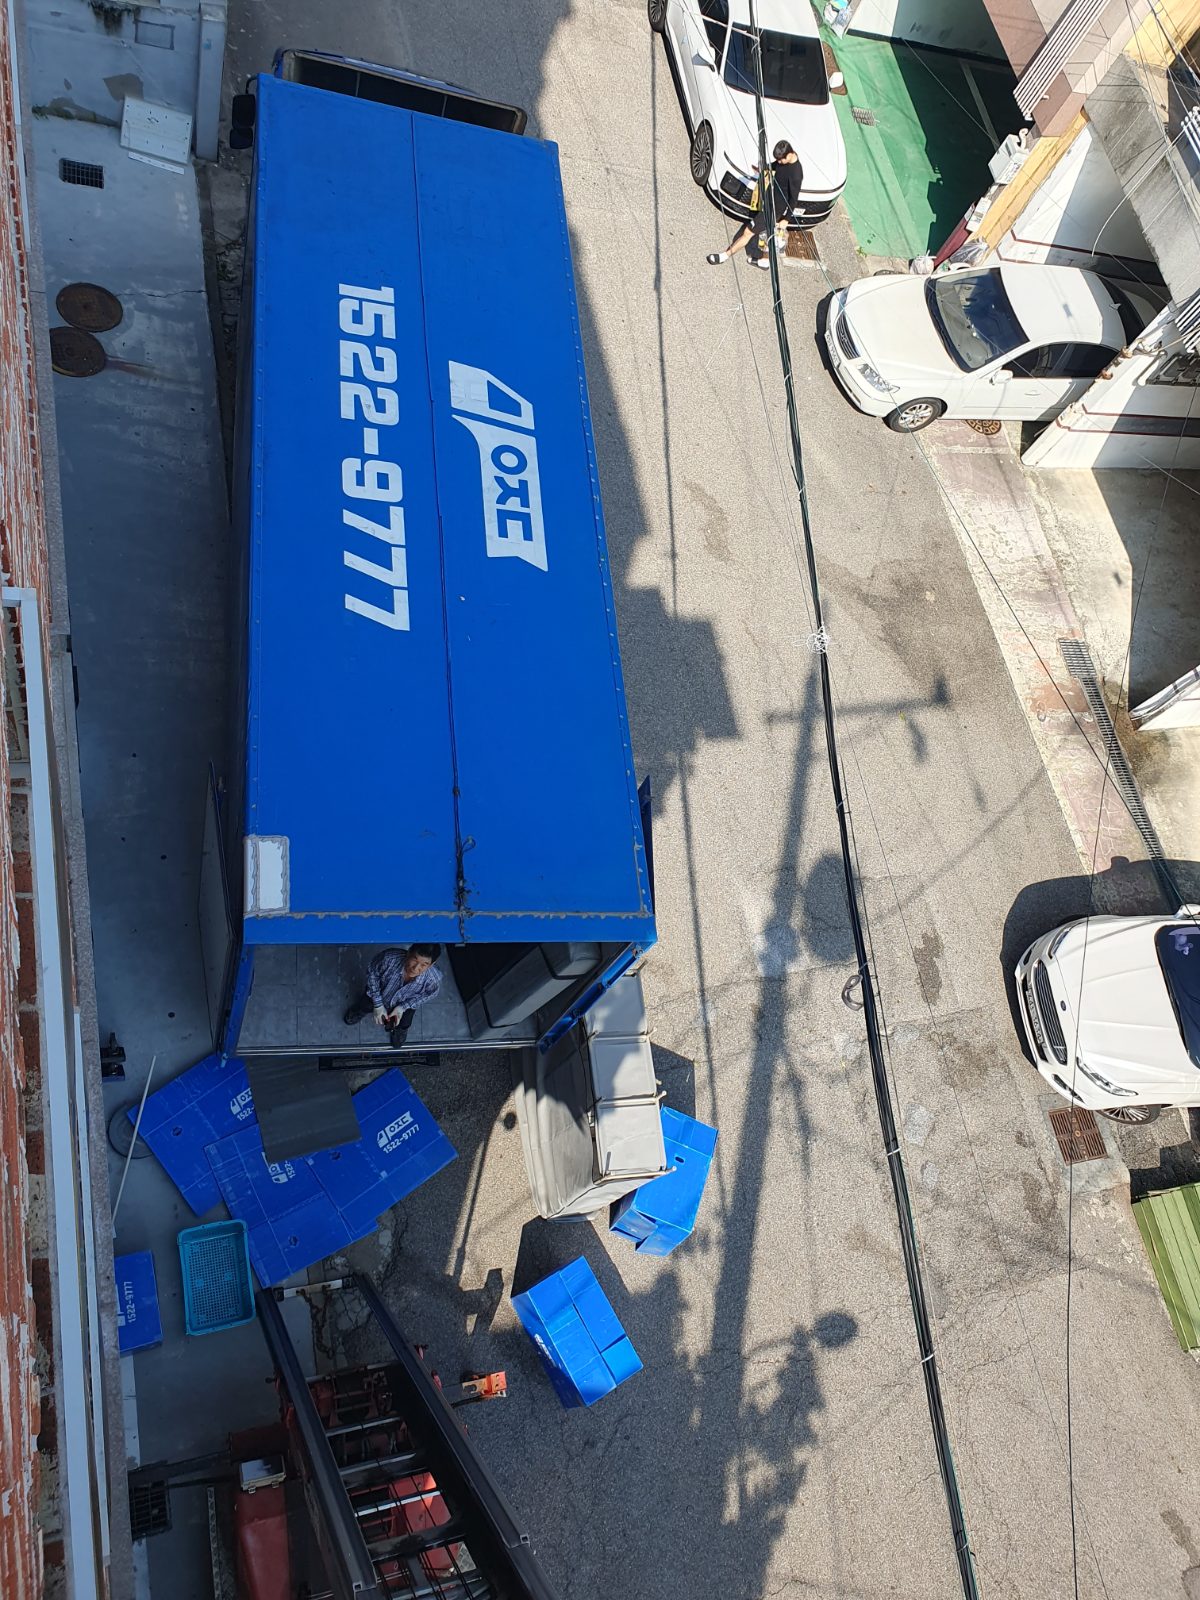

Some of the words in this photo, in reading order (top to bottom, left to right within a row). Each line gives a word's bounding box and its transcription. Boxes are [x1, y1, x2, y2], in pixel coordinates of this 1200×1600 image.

[338, 282, 411, 632] 1522-9777
[236, 1104, 255, 1121] 1522-
[383, 1123, 420, 1154] 1522-9777
[123, 1281, 137, 1323] 1522-9777
